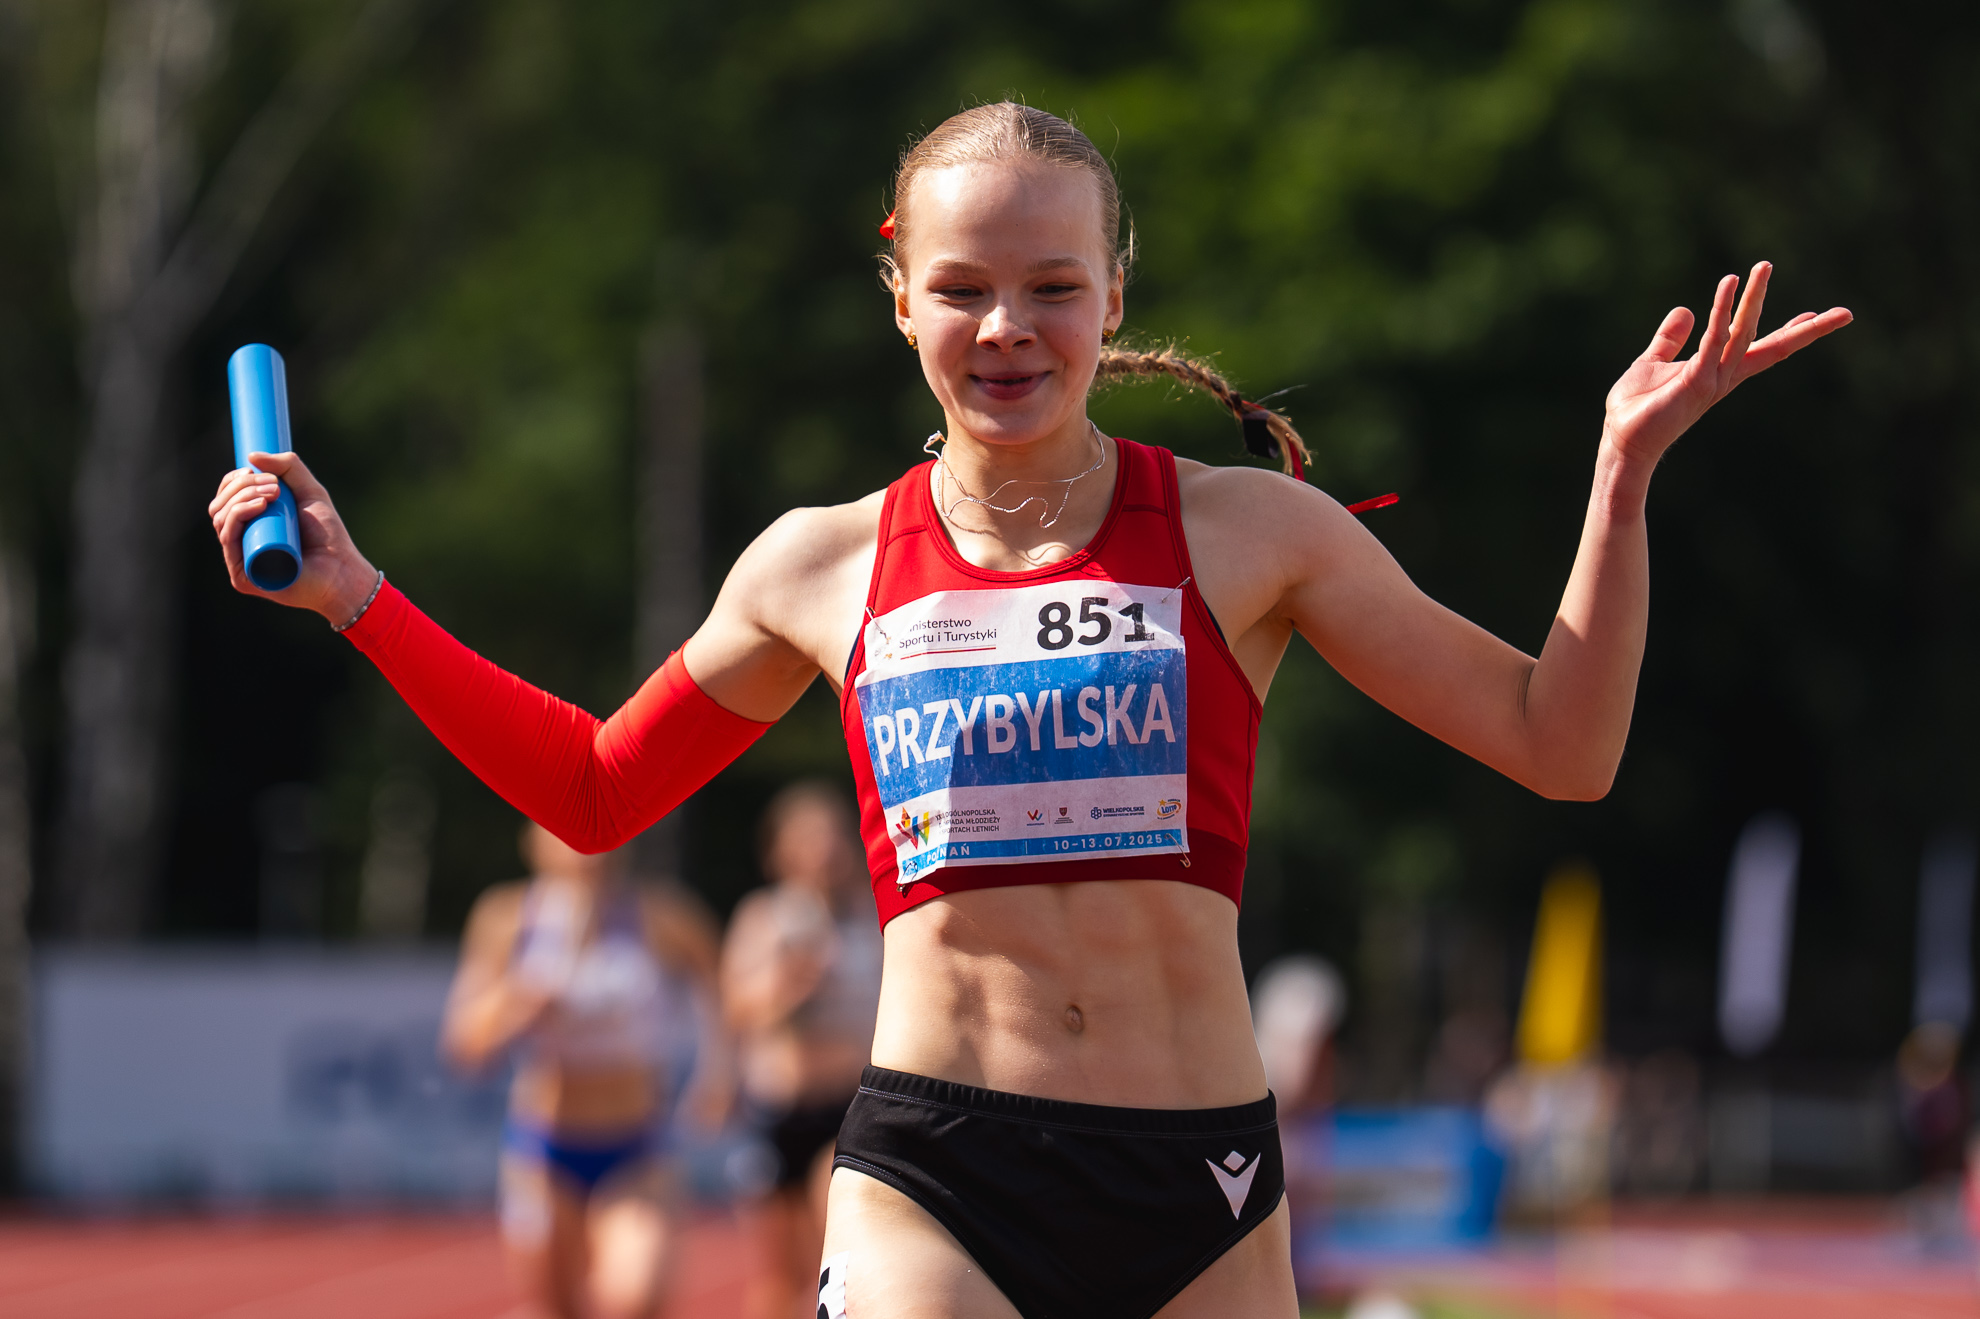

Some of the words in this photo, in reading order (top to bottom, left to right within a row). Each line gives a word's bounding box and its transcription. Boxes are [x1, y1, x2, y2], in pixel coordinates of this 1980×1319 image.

[909, 618, 972, 632] nisterstwo
[1037, 597, 1155, 650] 851
[899, 633, 934, 649] Sportu
[937, 631, 941, 642] i
[944, 629, 997, 642] Turystyki
[873, 683, 1176, 776] PRZYBYLSKA
[965, 816, 1001, 824] MŁODZIEŻY
[1054, 833, 1163, 850] 10-13.07.2025
